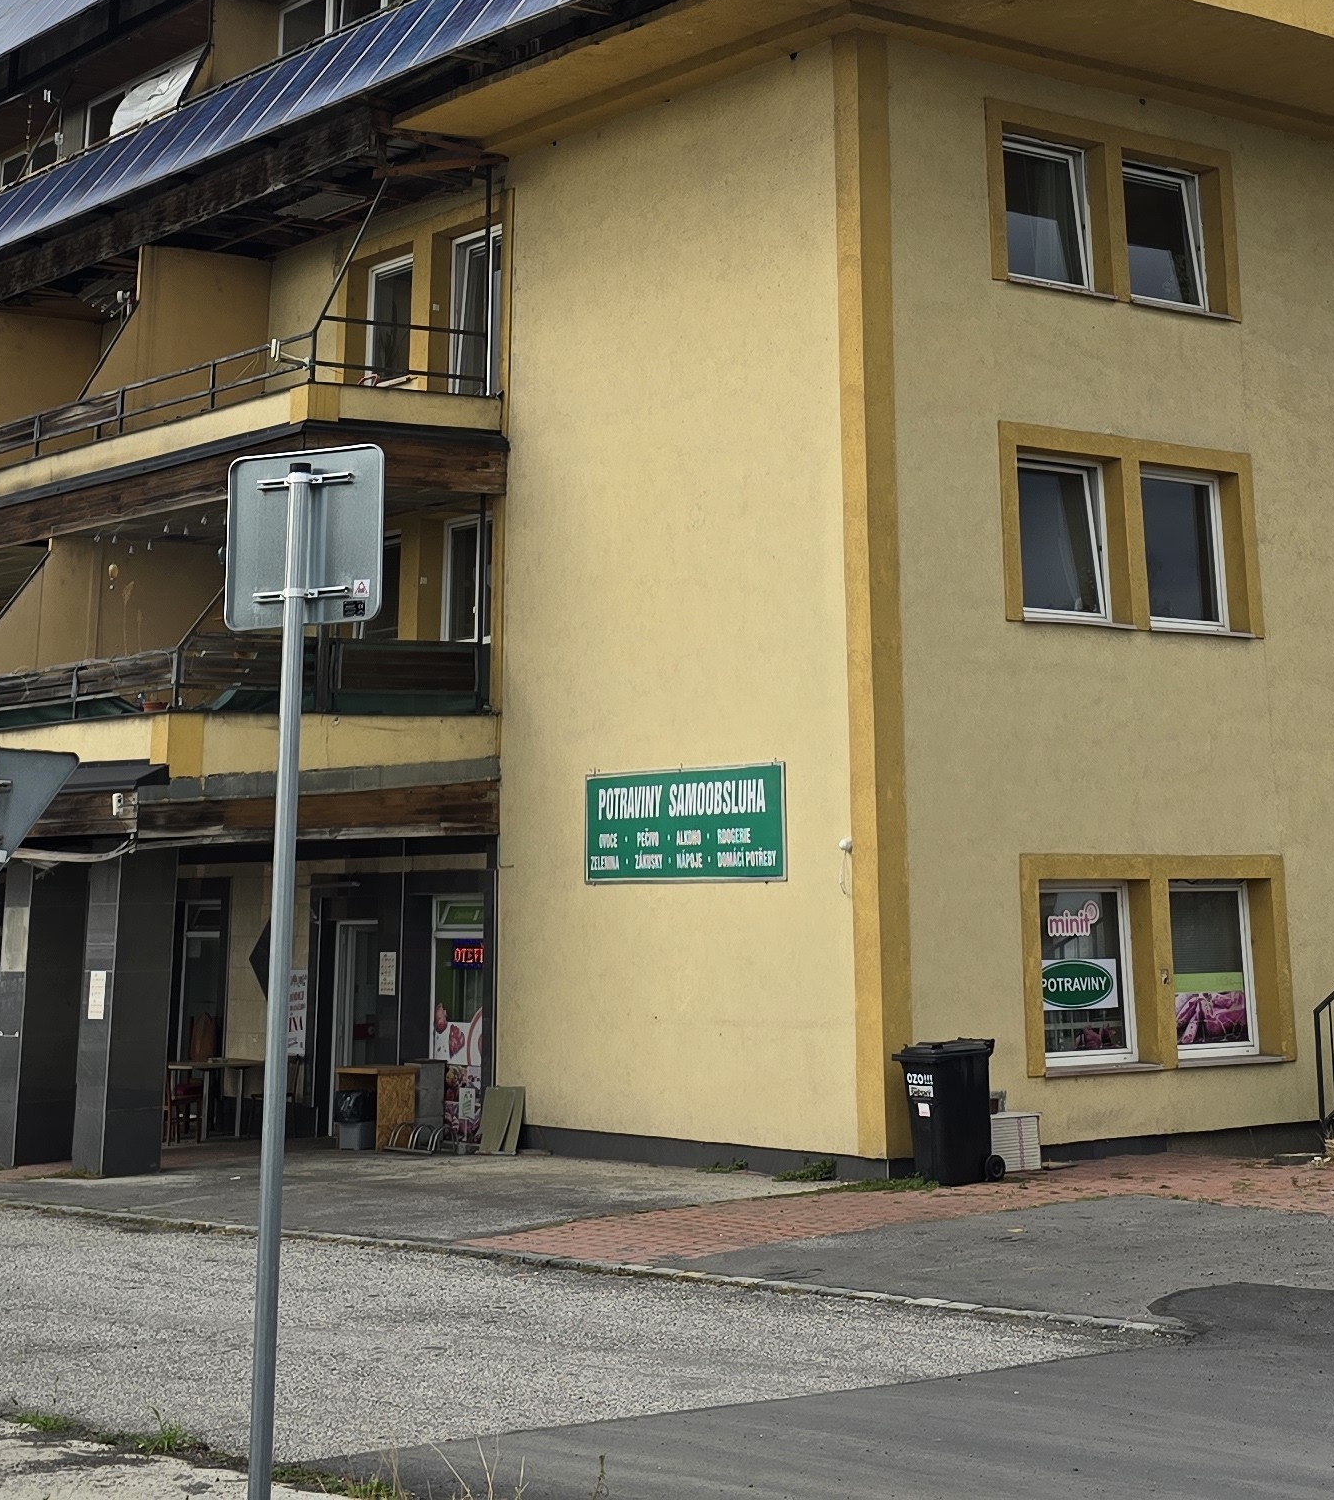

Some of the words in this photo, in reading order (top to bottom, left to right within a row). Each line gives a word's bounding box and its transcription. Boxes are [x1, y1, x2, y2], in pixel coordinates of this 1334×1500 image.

[598, 785, 662, 820] POTRAVINY
[668, 778, 766, 817] SAMOOBSLUHA
[676, 849, 703, 868] NÁPOJE
[717, 846, 744, 867] DOMÁCÍ
[745, 846, 777, 867] POTŘEBY
[1048, 910, 1090, 936] minit
